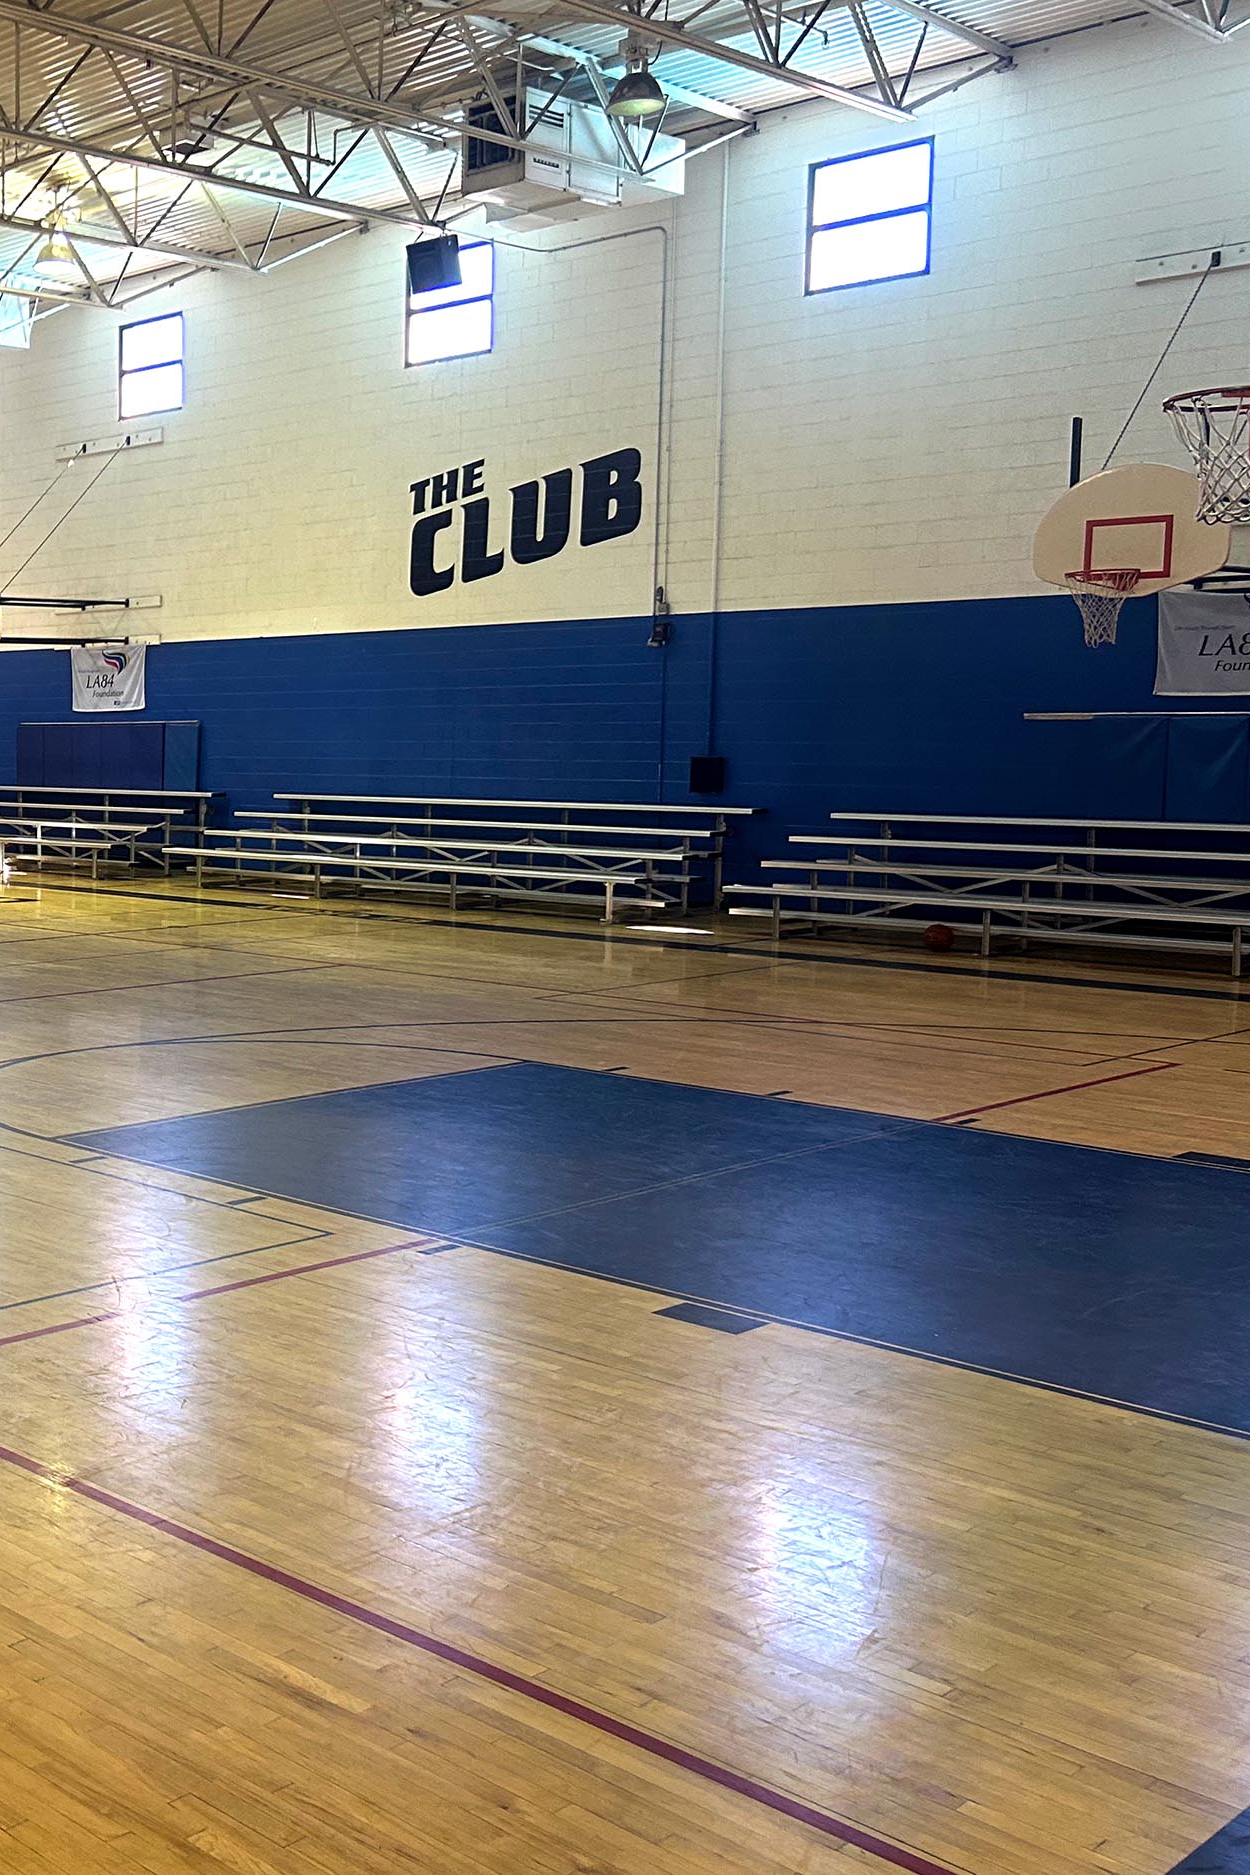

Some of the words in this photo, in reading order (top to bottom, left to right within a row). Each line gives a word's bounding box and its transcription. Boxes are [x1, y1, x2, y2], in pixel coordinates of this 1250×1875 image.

[409, 458, 485, 515] THE
[410, 448, 642, 597] CLUB
[86, 674, 114, 688] LA84
[92, 689, 124, 698] Foundation
